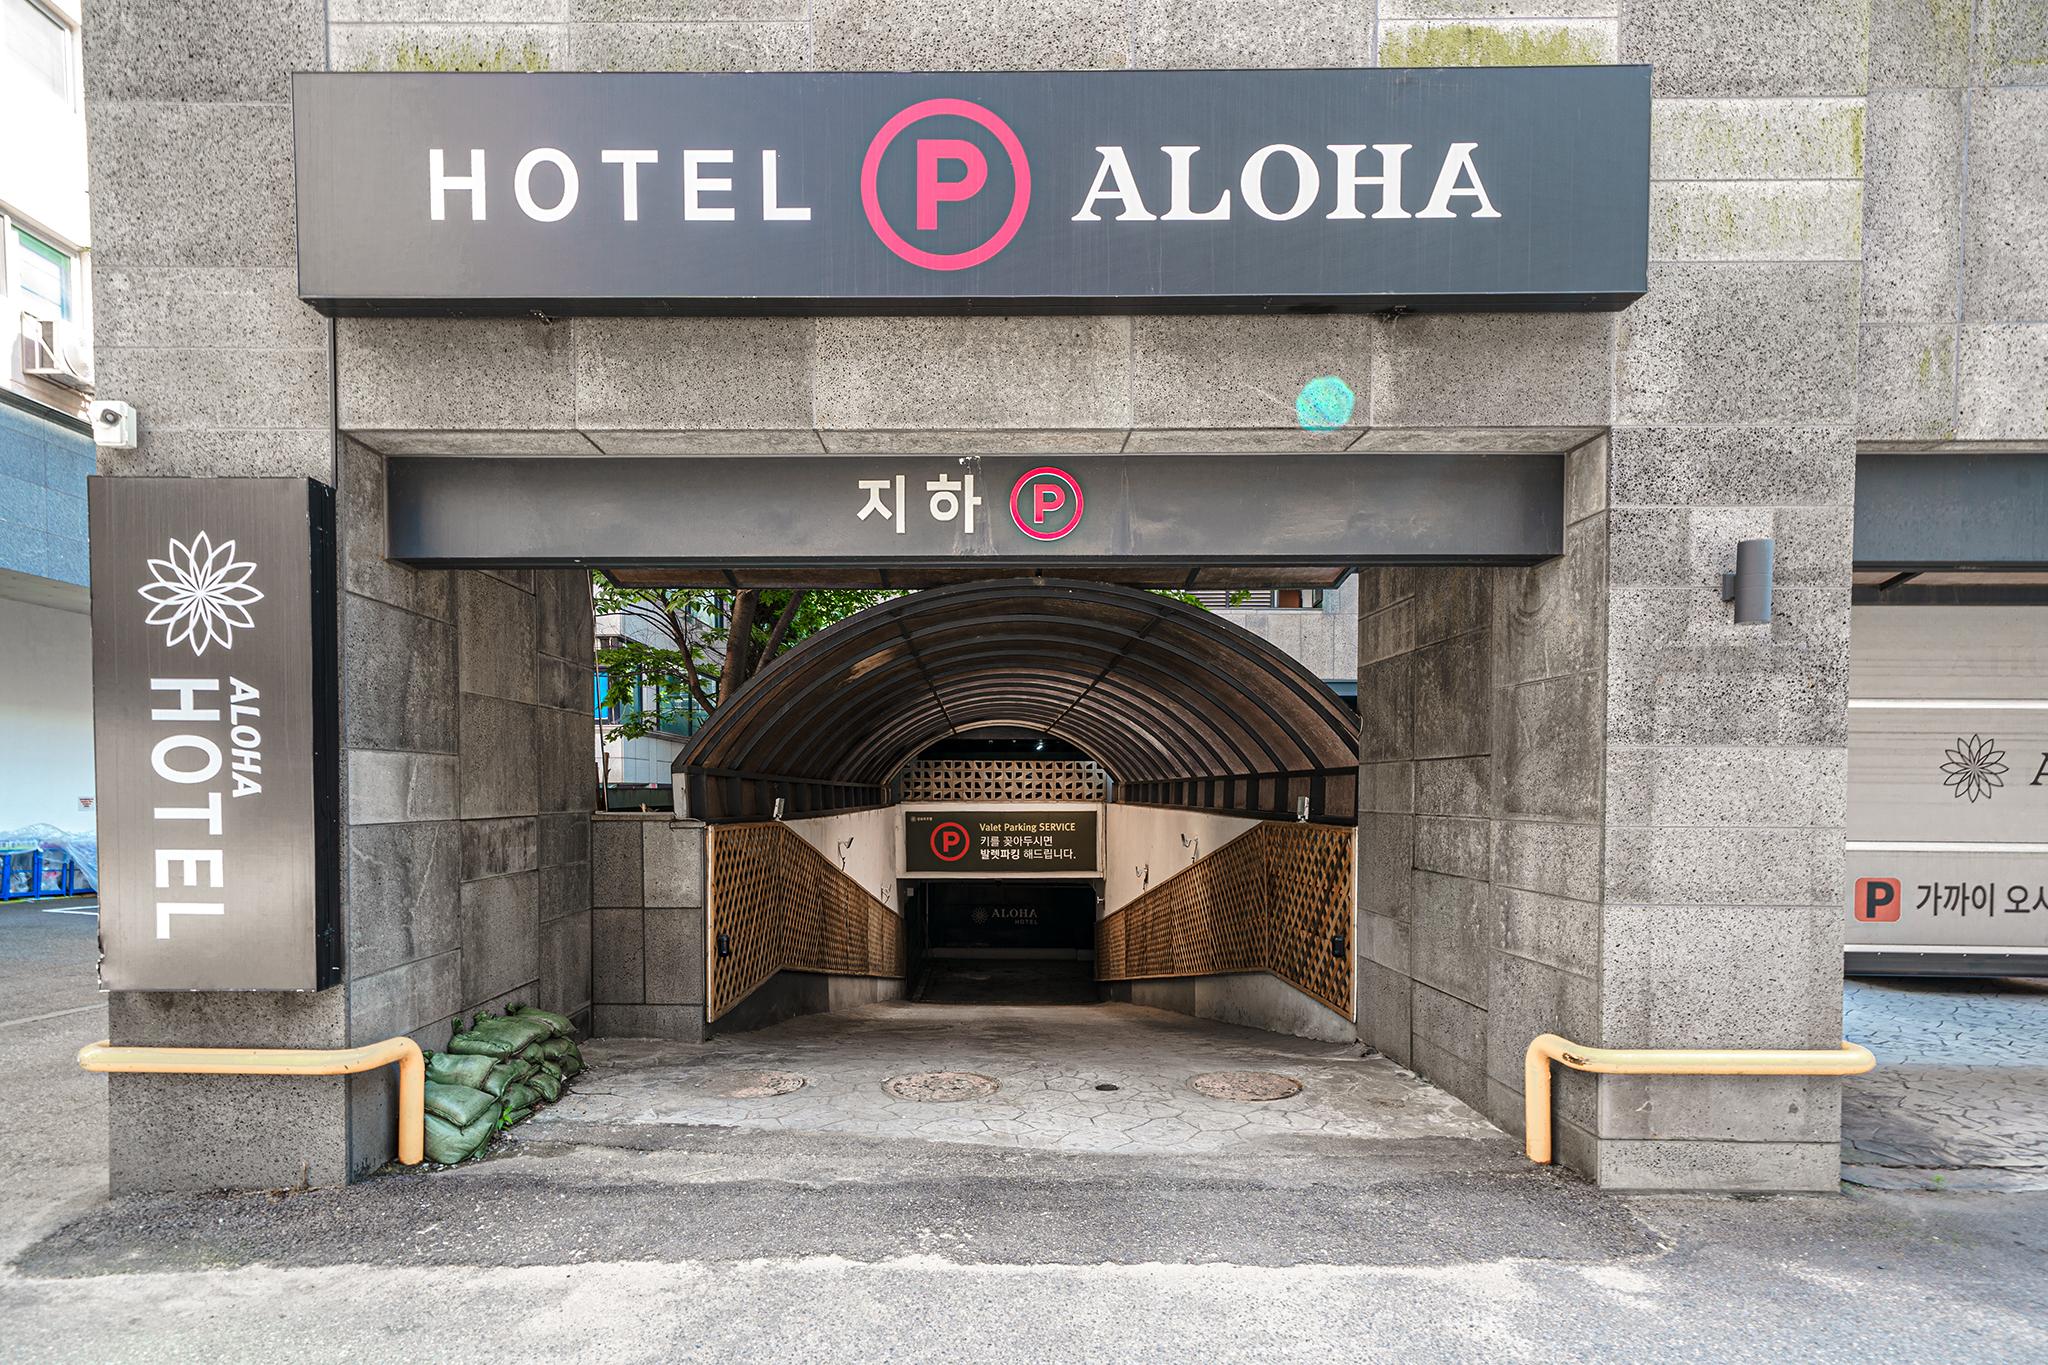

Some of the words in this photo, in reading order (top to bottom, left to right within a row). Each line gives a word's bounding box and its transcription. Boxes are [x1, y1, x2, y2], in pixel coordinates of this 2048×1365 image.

[429, 147, 812, 222] HOTEL
[1071, 142, 1502, 221] ALOHA
[856, 473, 982, 534] 지하
[229, 676, 262, 798] ALOHA
[150, 678, 225, 940] HOTEL
[979, 823, 1002, 832] Valet
[1004, 822, 1037, 833] Parking
[1039, 822, 1076, 832] SERVICE
[980, 836, 1000, 847] 키를
[980, 849, 1020, 860] 발렛파킹
[1023, 849, 1077, 860] 해드립니다.
[991, 908, 1038, 918] ALOHA
[1916, 882, 1995, 917] 가까이
